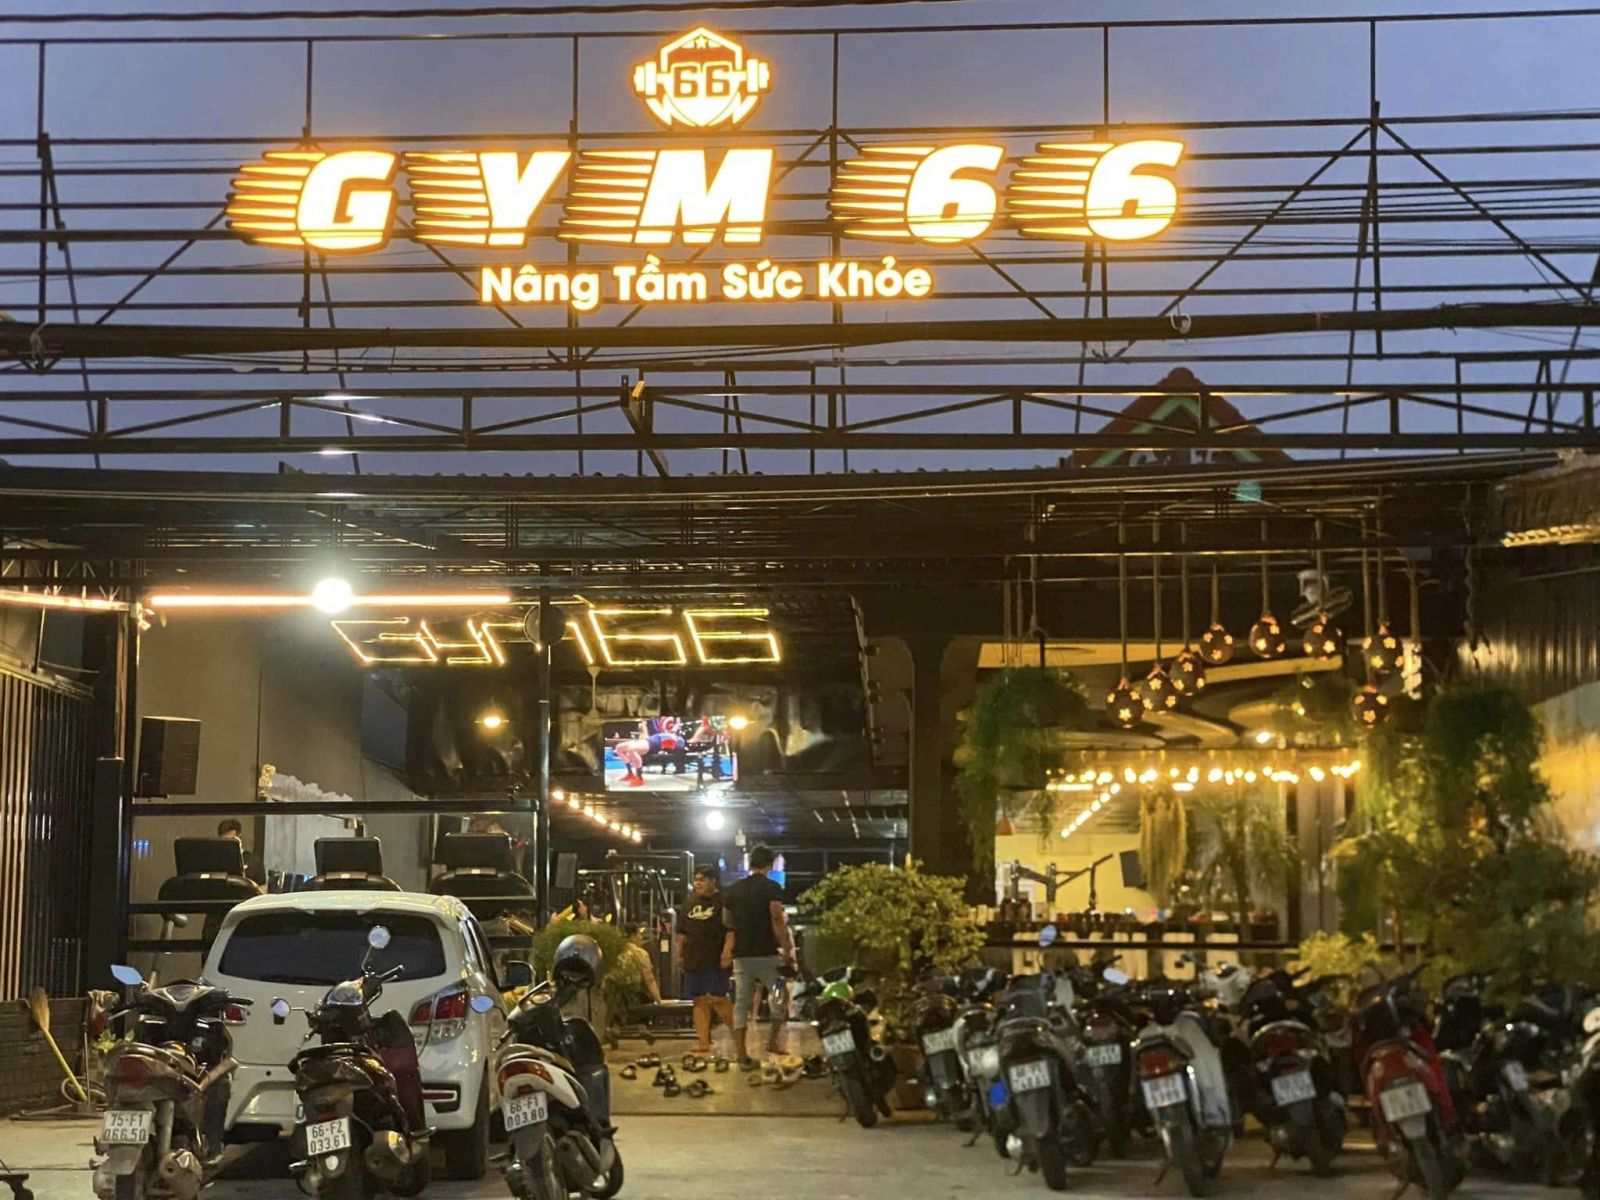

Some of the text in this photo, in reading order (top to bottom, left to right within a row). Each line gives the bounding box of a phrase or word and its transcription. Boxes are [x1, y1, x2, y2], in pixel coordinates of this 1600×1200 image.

[673, 64, 731, 98] 66
[297, 140, 1185, 250] GYM 66
[481, 255, 933, 311] Nâng Tầm Sức Khỏe
[110, 1113, 144, 1127] 75-F1
